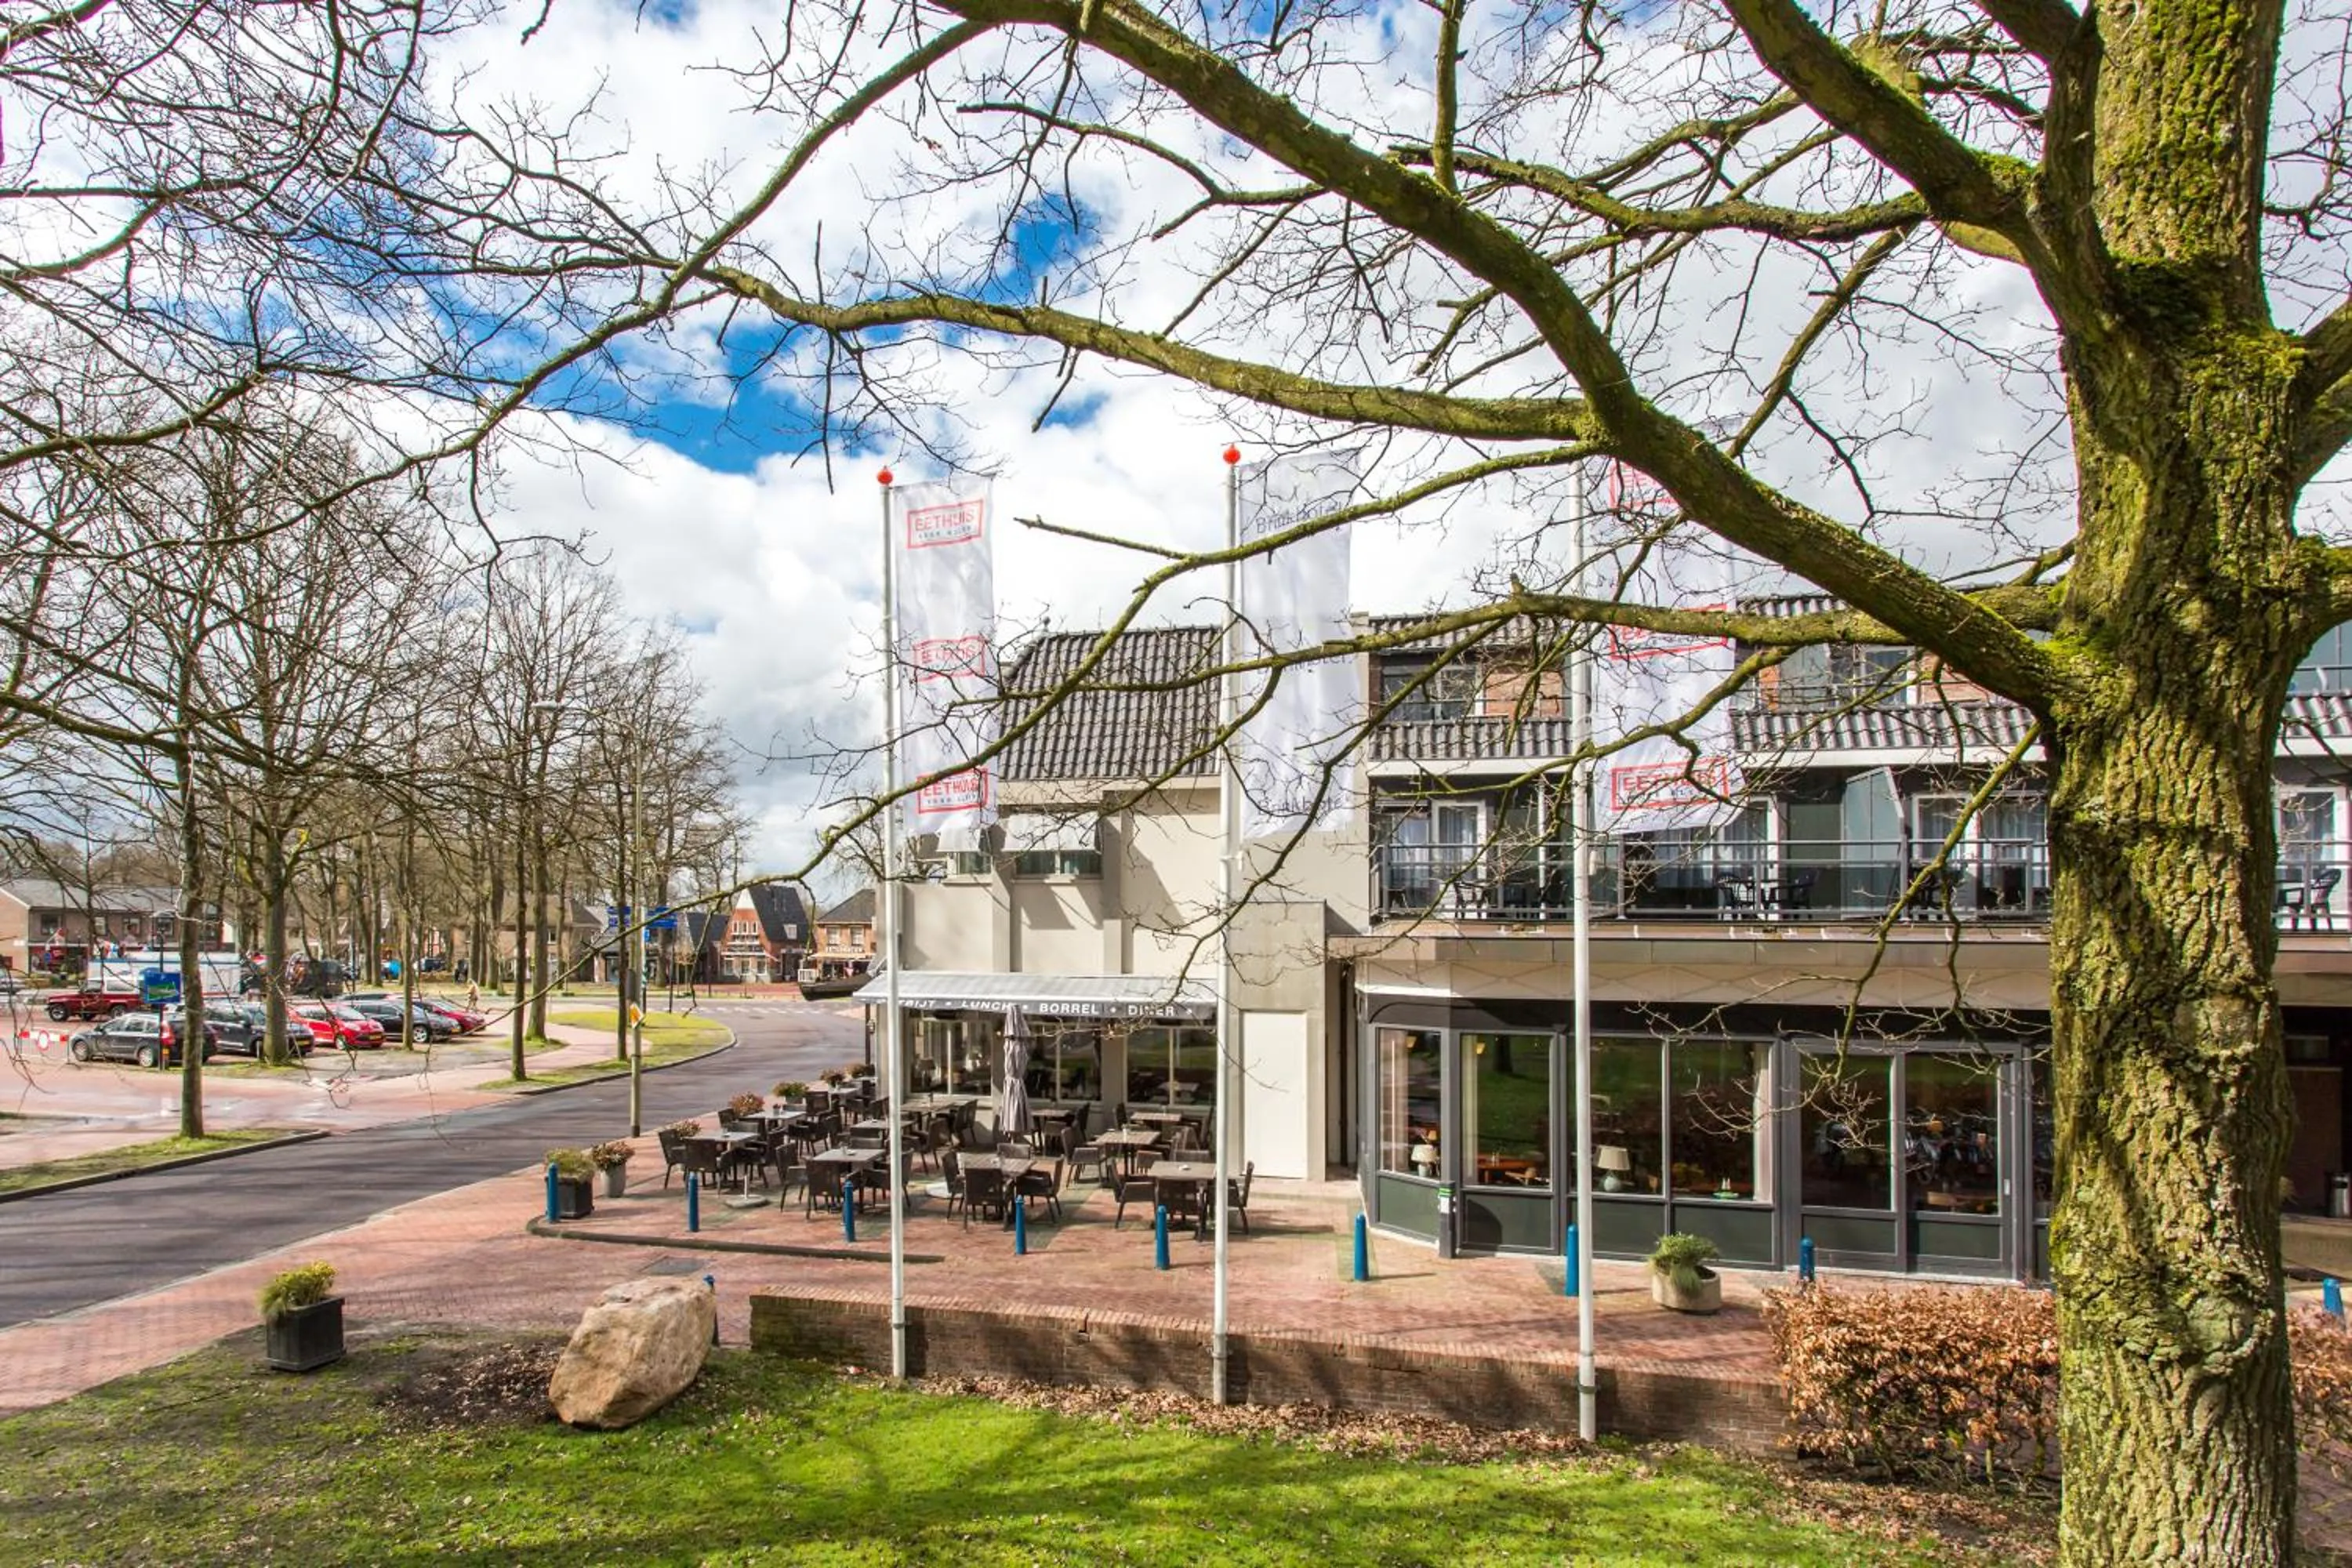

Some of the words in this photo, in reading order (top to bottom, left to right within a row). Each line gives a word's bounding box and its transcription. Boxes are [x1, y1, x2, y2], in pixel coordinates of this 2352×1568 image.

[915, 509, 975, 532] EETHUIS
[961, 1000, 1016, 1011] LUNCH
[1039, 1003, 1099, 1014] BORREL
